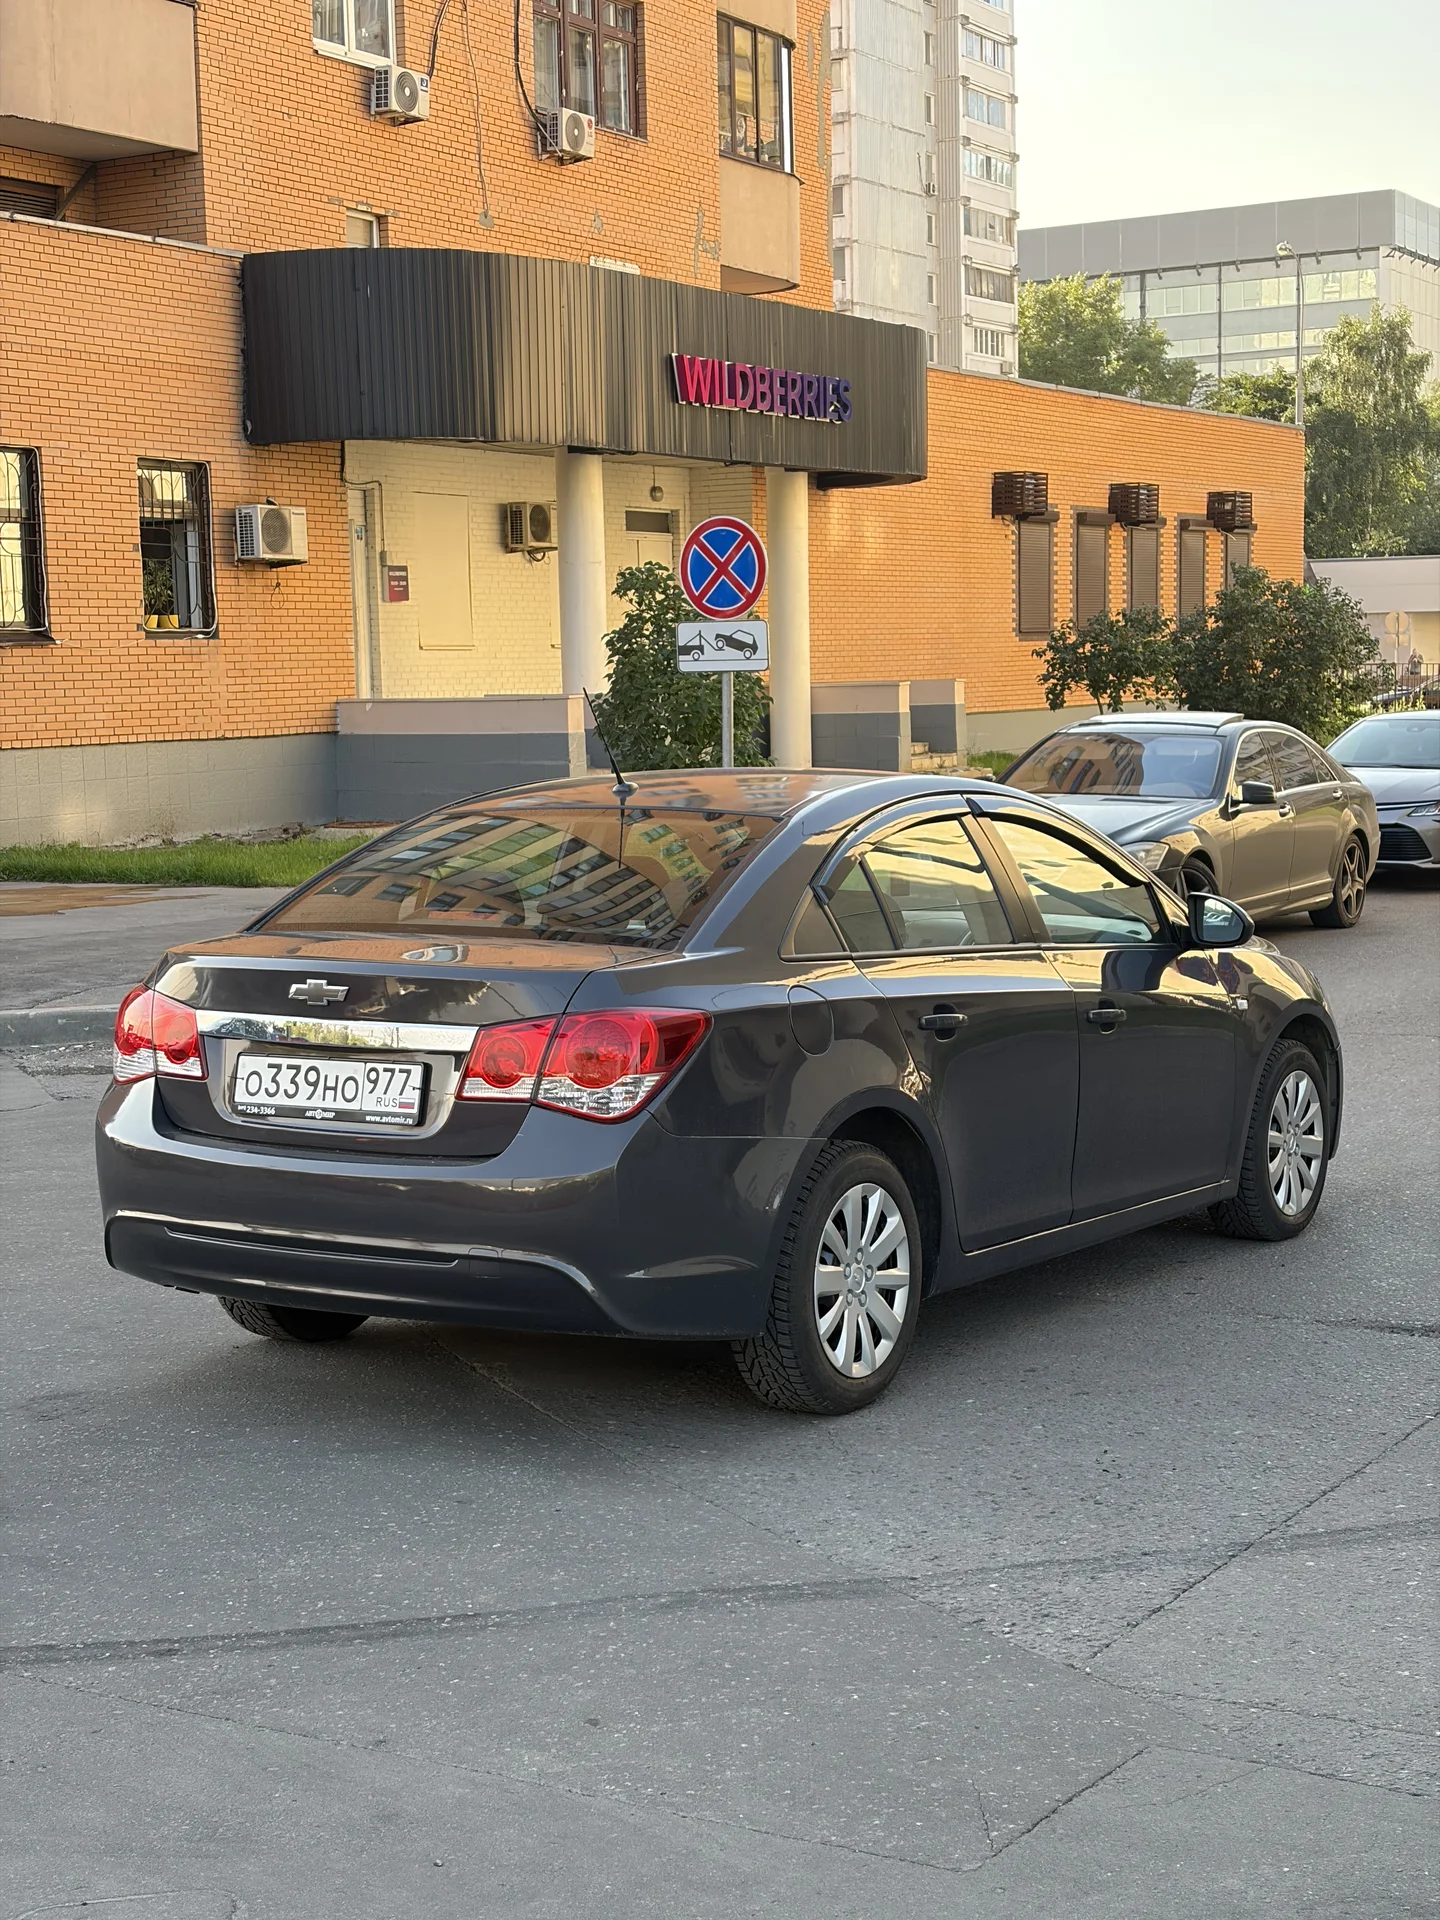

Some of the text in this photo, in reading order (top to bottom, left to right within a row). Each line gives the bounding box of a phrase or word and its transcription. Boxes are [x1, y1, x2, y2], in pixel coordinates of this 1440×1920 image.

[674, 353, 853, 423] WILDBERRIES
[366, 1066, 412, 1096] 977
[375, 1097, 398, 1108] RUS
[246, 1106, 276, 1115] 234-3366
[365, 1115, 413, 1125] www.avtomir.ru
